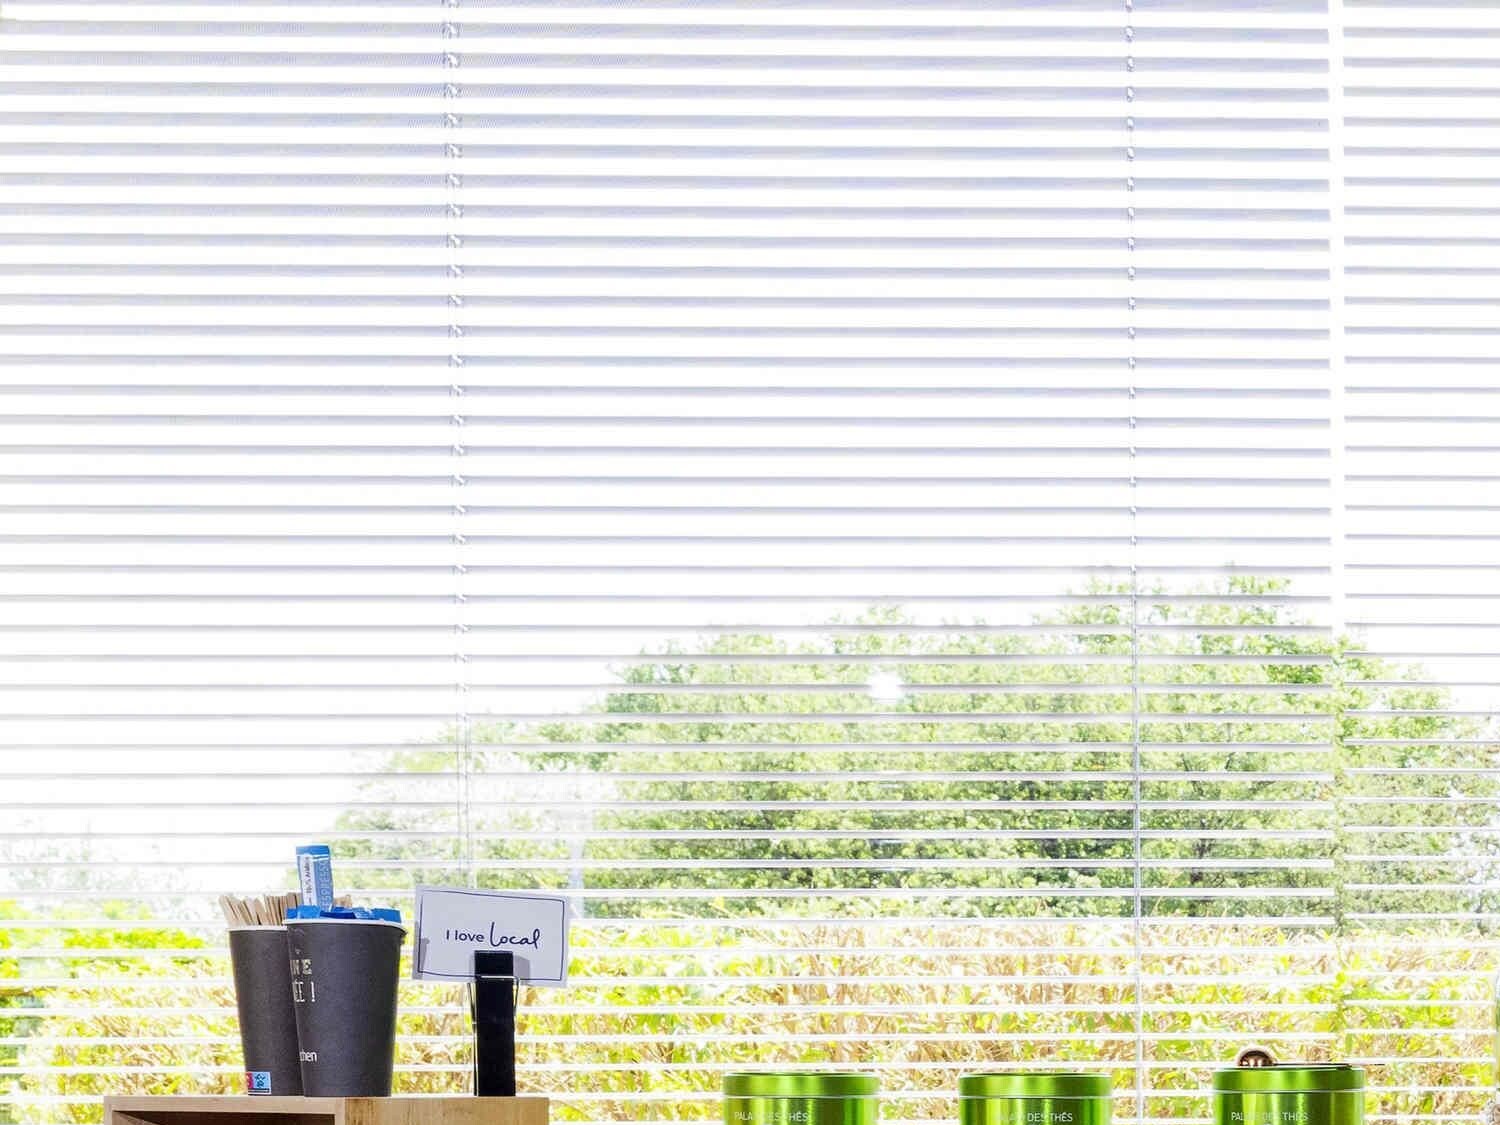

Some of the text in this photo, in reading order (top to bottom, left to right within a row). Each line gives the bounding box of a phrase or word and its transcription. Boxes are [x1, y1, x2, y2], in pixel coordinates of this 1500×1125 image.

[446, 921, 541, 949] I love Local
[785, 1110, 809, 1122] HÉS
